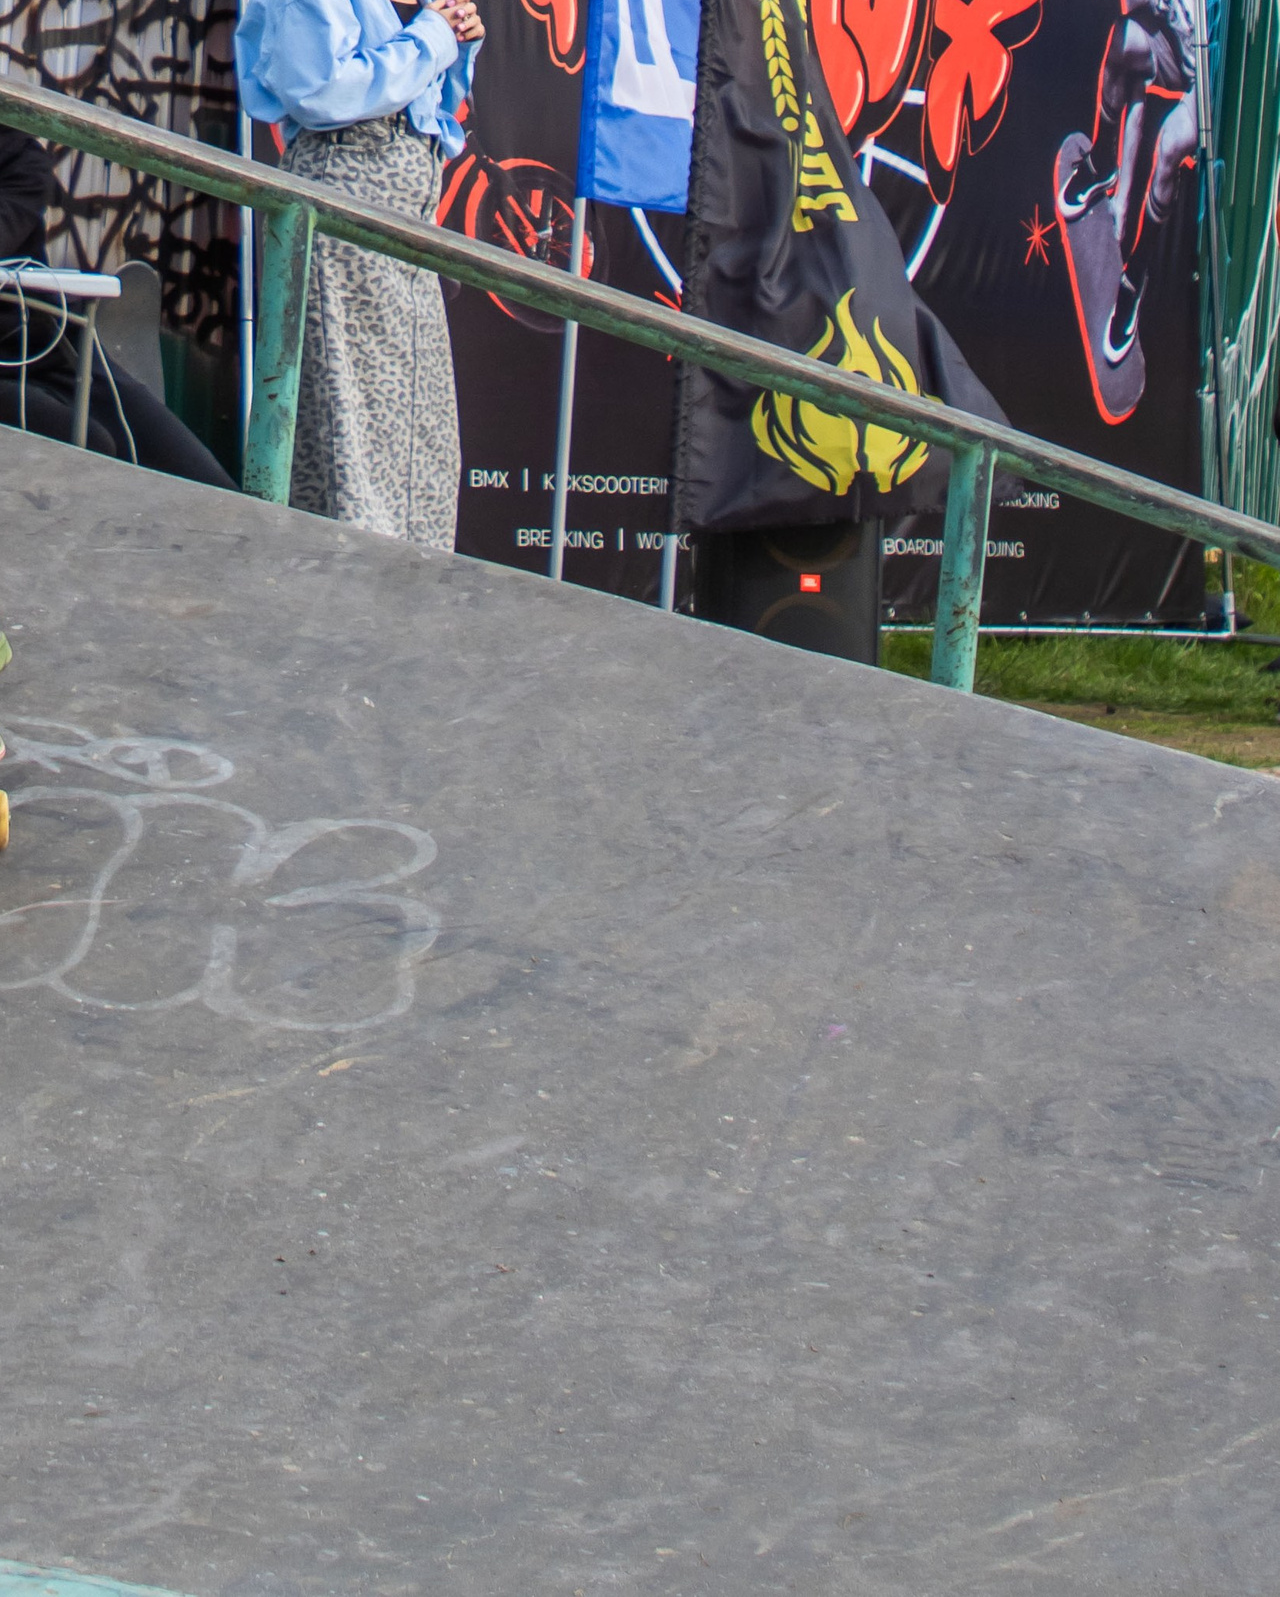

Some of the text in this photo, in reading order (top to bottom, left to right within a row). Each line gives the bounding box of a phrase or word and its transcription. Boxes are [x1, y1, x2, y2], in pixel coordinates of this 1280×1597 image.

[470, 468, 1060, 510] BMX KKSCOOTERI CKING
[516, 528, 605, 549] BREKING
